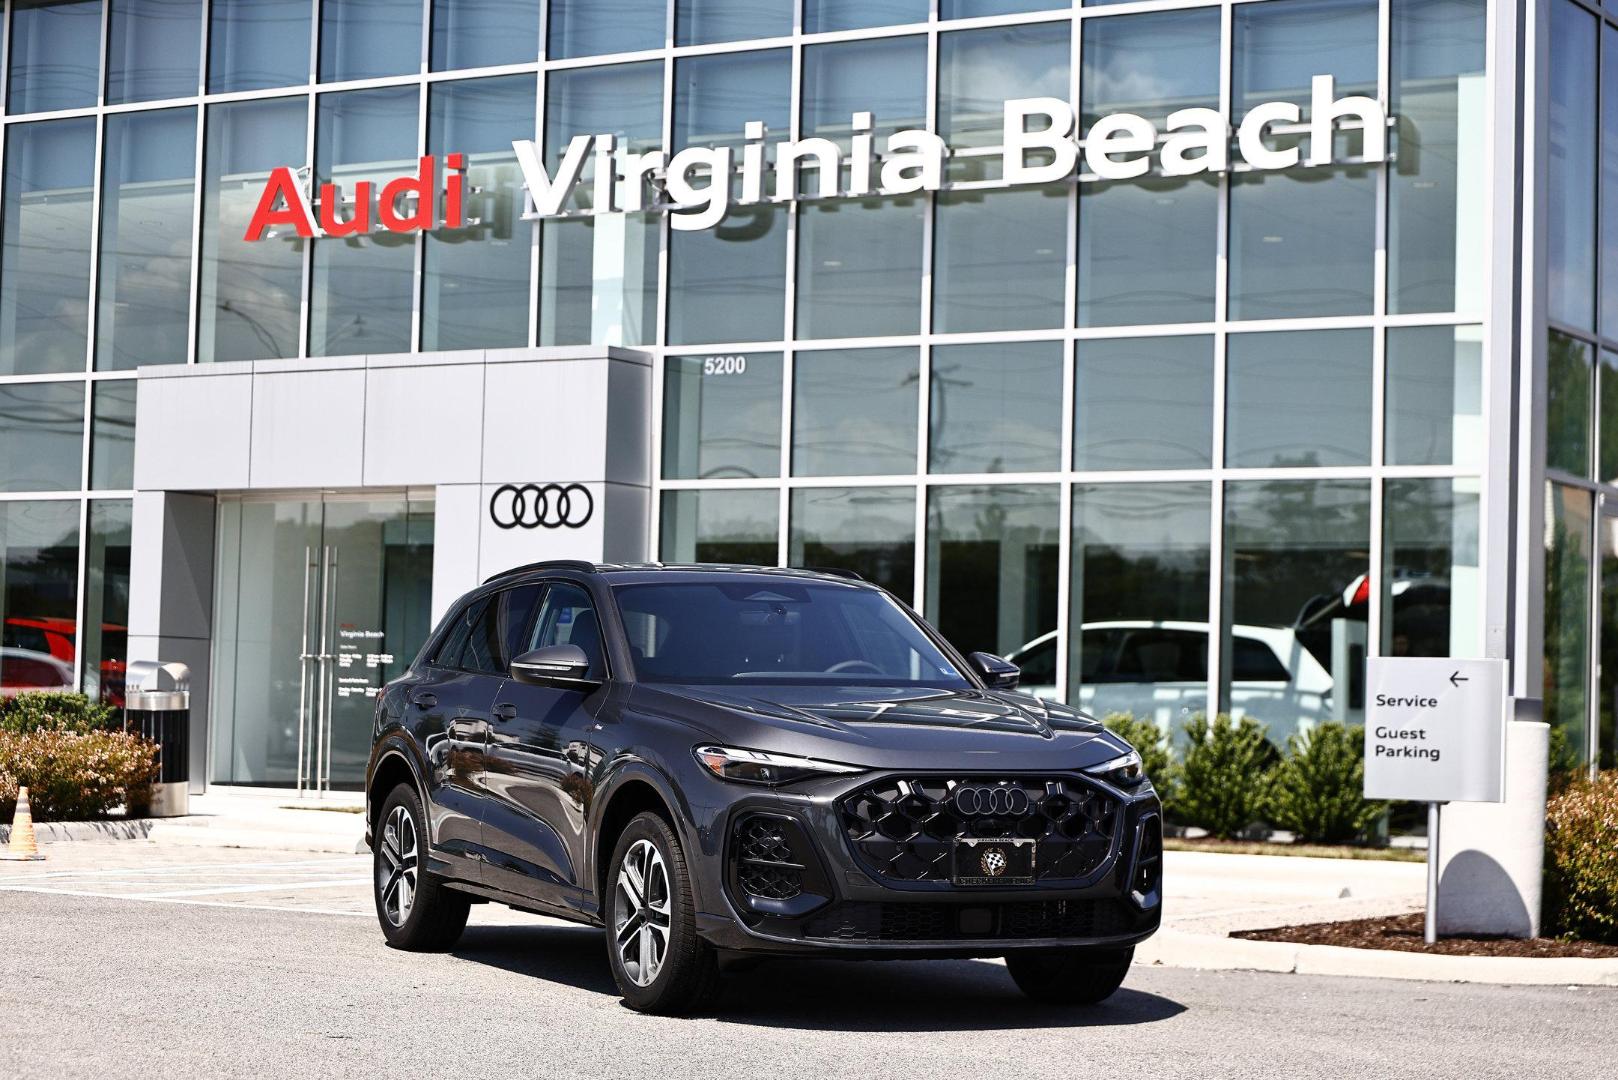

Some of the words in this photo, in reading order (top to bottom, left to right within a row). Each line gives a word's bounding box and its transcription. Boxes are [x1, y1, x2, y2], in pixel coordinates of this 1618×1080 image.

[244, 153, 466, 241] Audi
[512, 112, 945, 230] Virginia
[1003, 74, 1388, 185] Beach
[704, 356, 746, 375] 5200
[1376, 694, 1438, 707] Service
[1375, 726, 1426, 739] Guest
[1375, 745, 1440, 762] Parking
